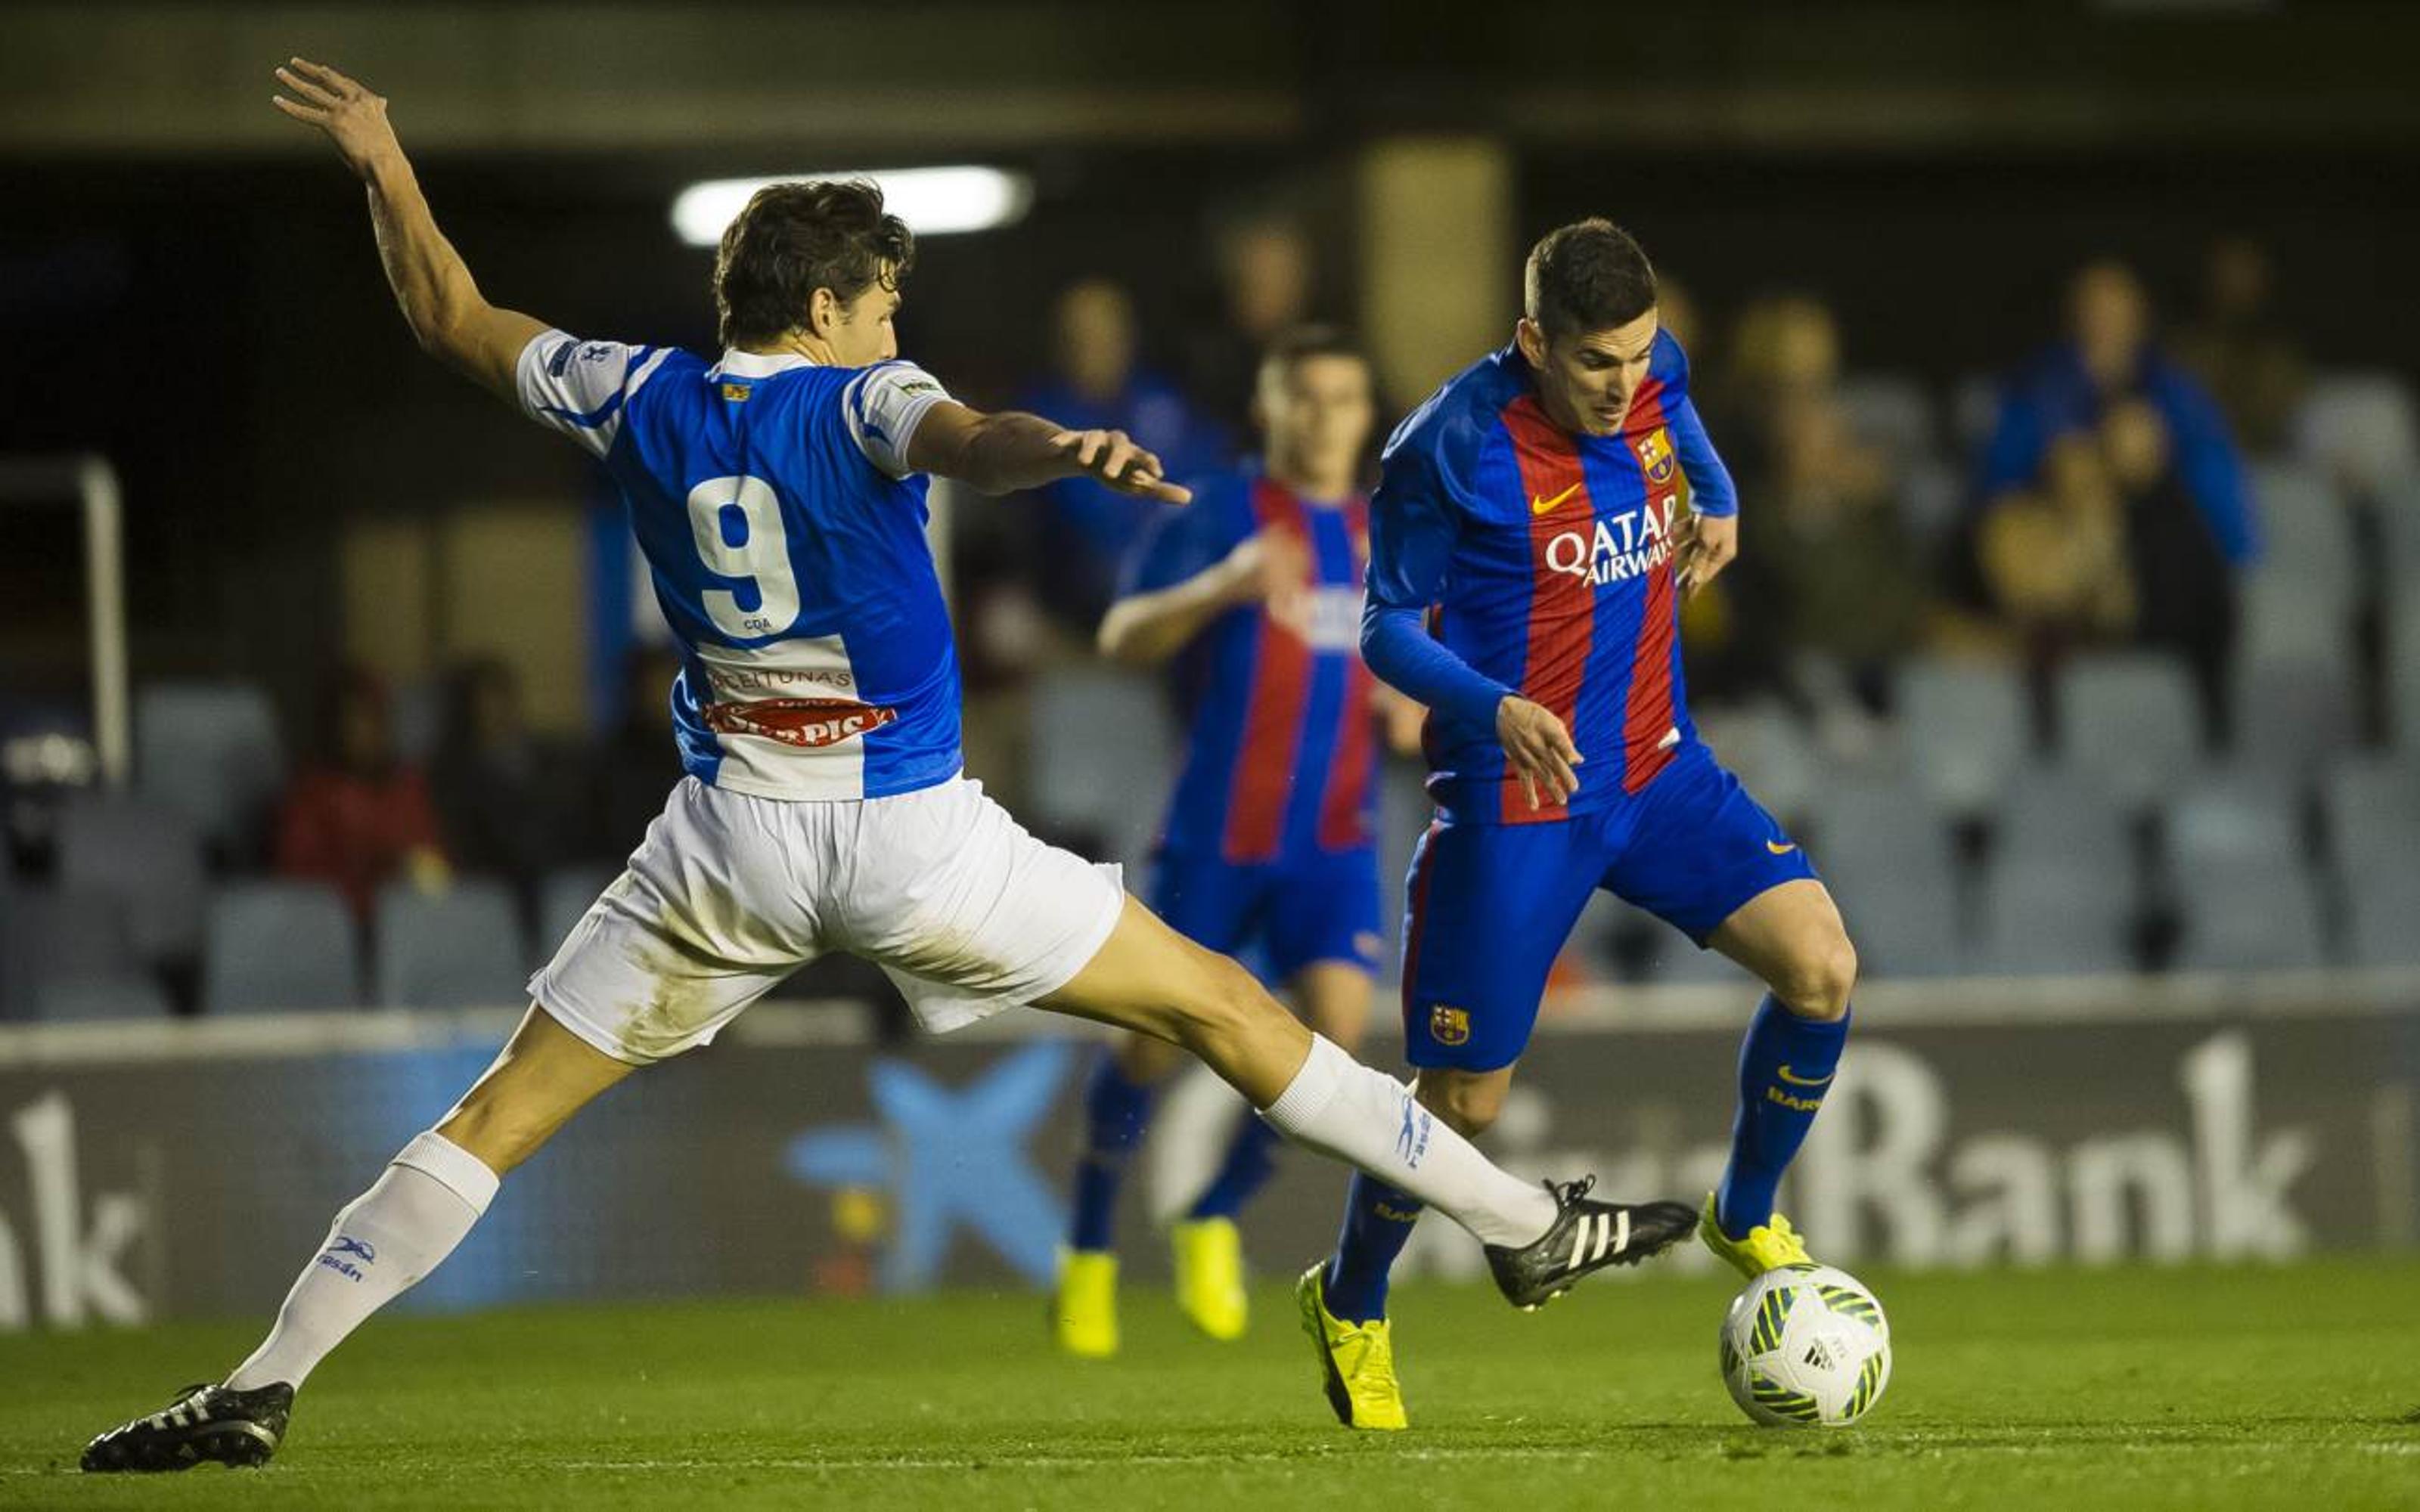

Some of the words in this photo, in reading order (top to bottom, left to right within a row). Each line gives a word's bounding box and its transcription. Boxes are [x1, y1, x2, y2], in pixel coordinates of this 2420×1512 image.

[687, 476, 800, 638] 9
[1546, 494, 1676, 575] QATAR
[744, 618, 772, 630] CDA
